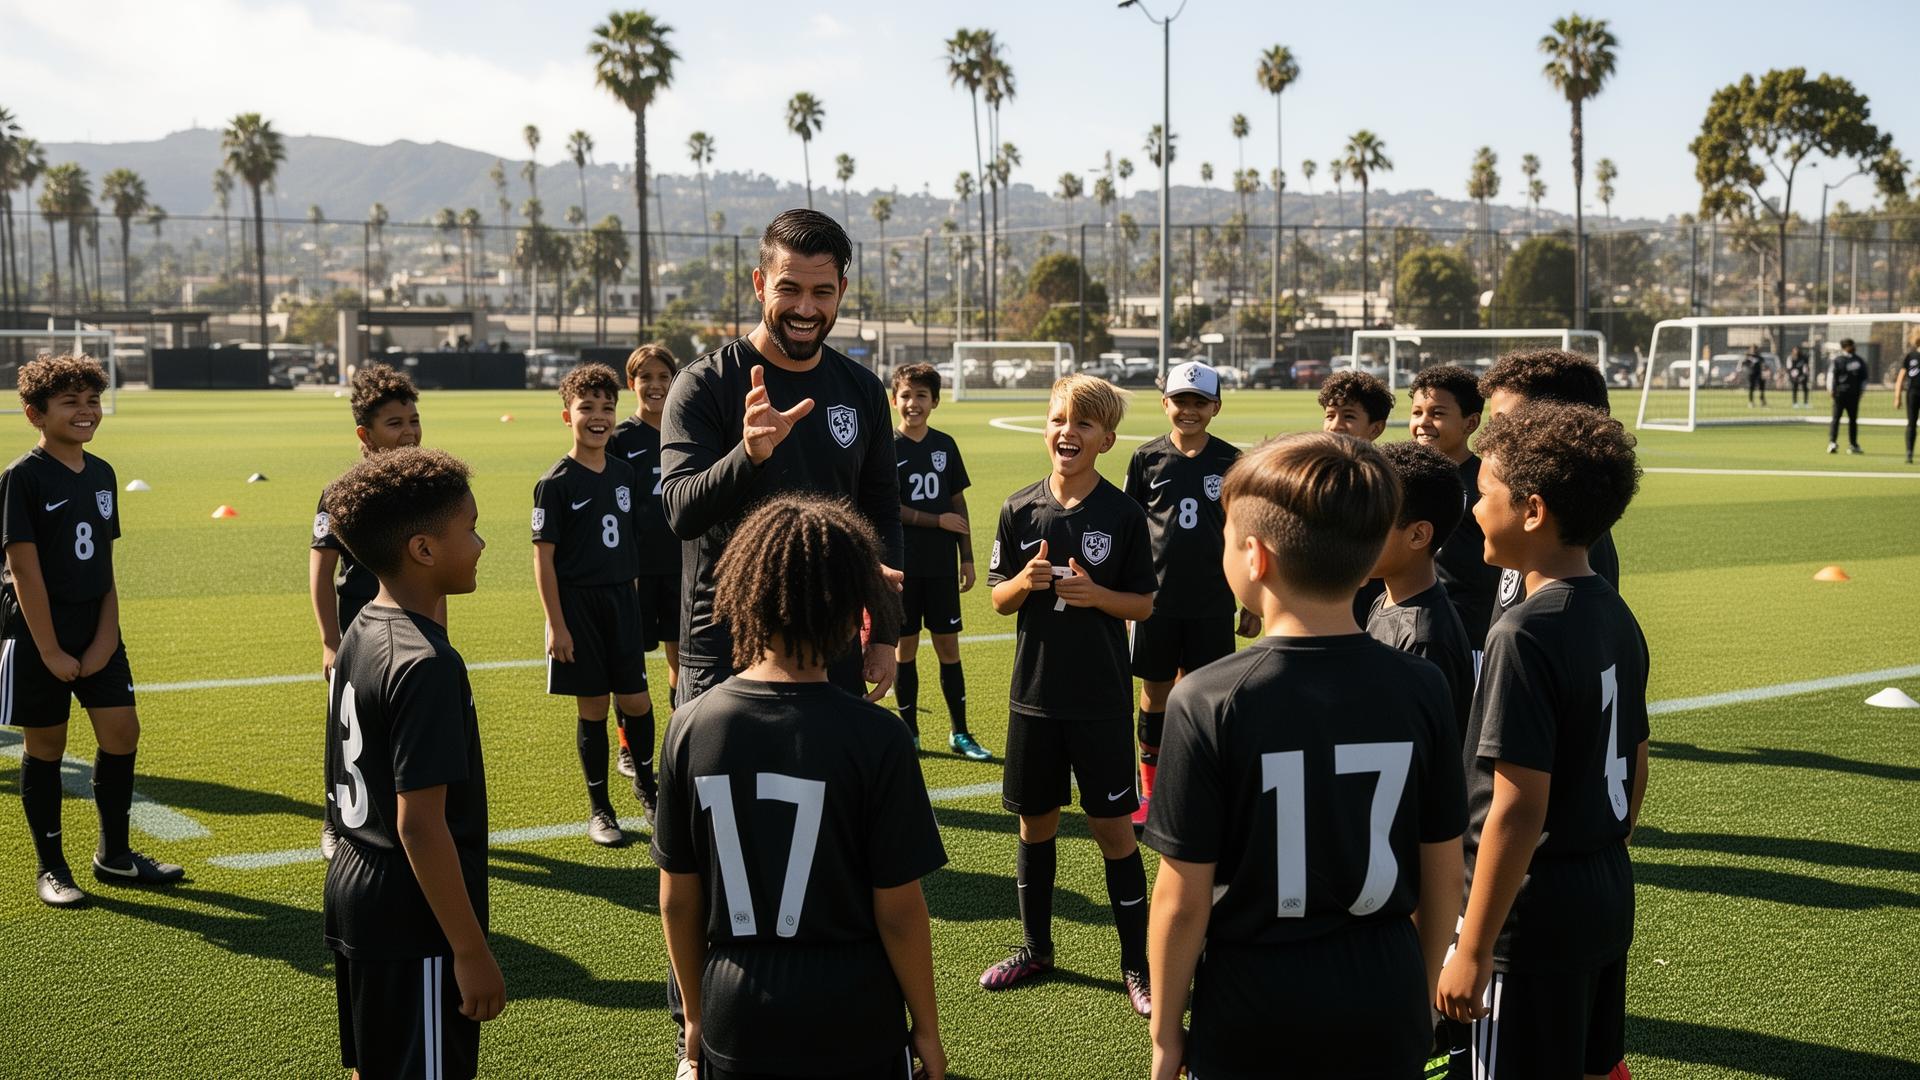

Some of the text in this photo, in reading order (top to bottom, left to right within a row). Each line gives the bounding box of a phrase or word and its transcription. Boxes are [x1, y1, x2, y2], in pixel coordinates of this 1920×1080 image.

[909, 472, 939, 500] 20
[1179, 498, 1198, 529] 8
[75, 522, 94, 560] 8
[602, 514, 619, 548] 8
[694, 772, 826, 937] 17
